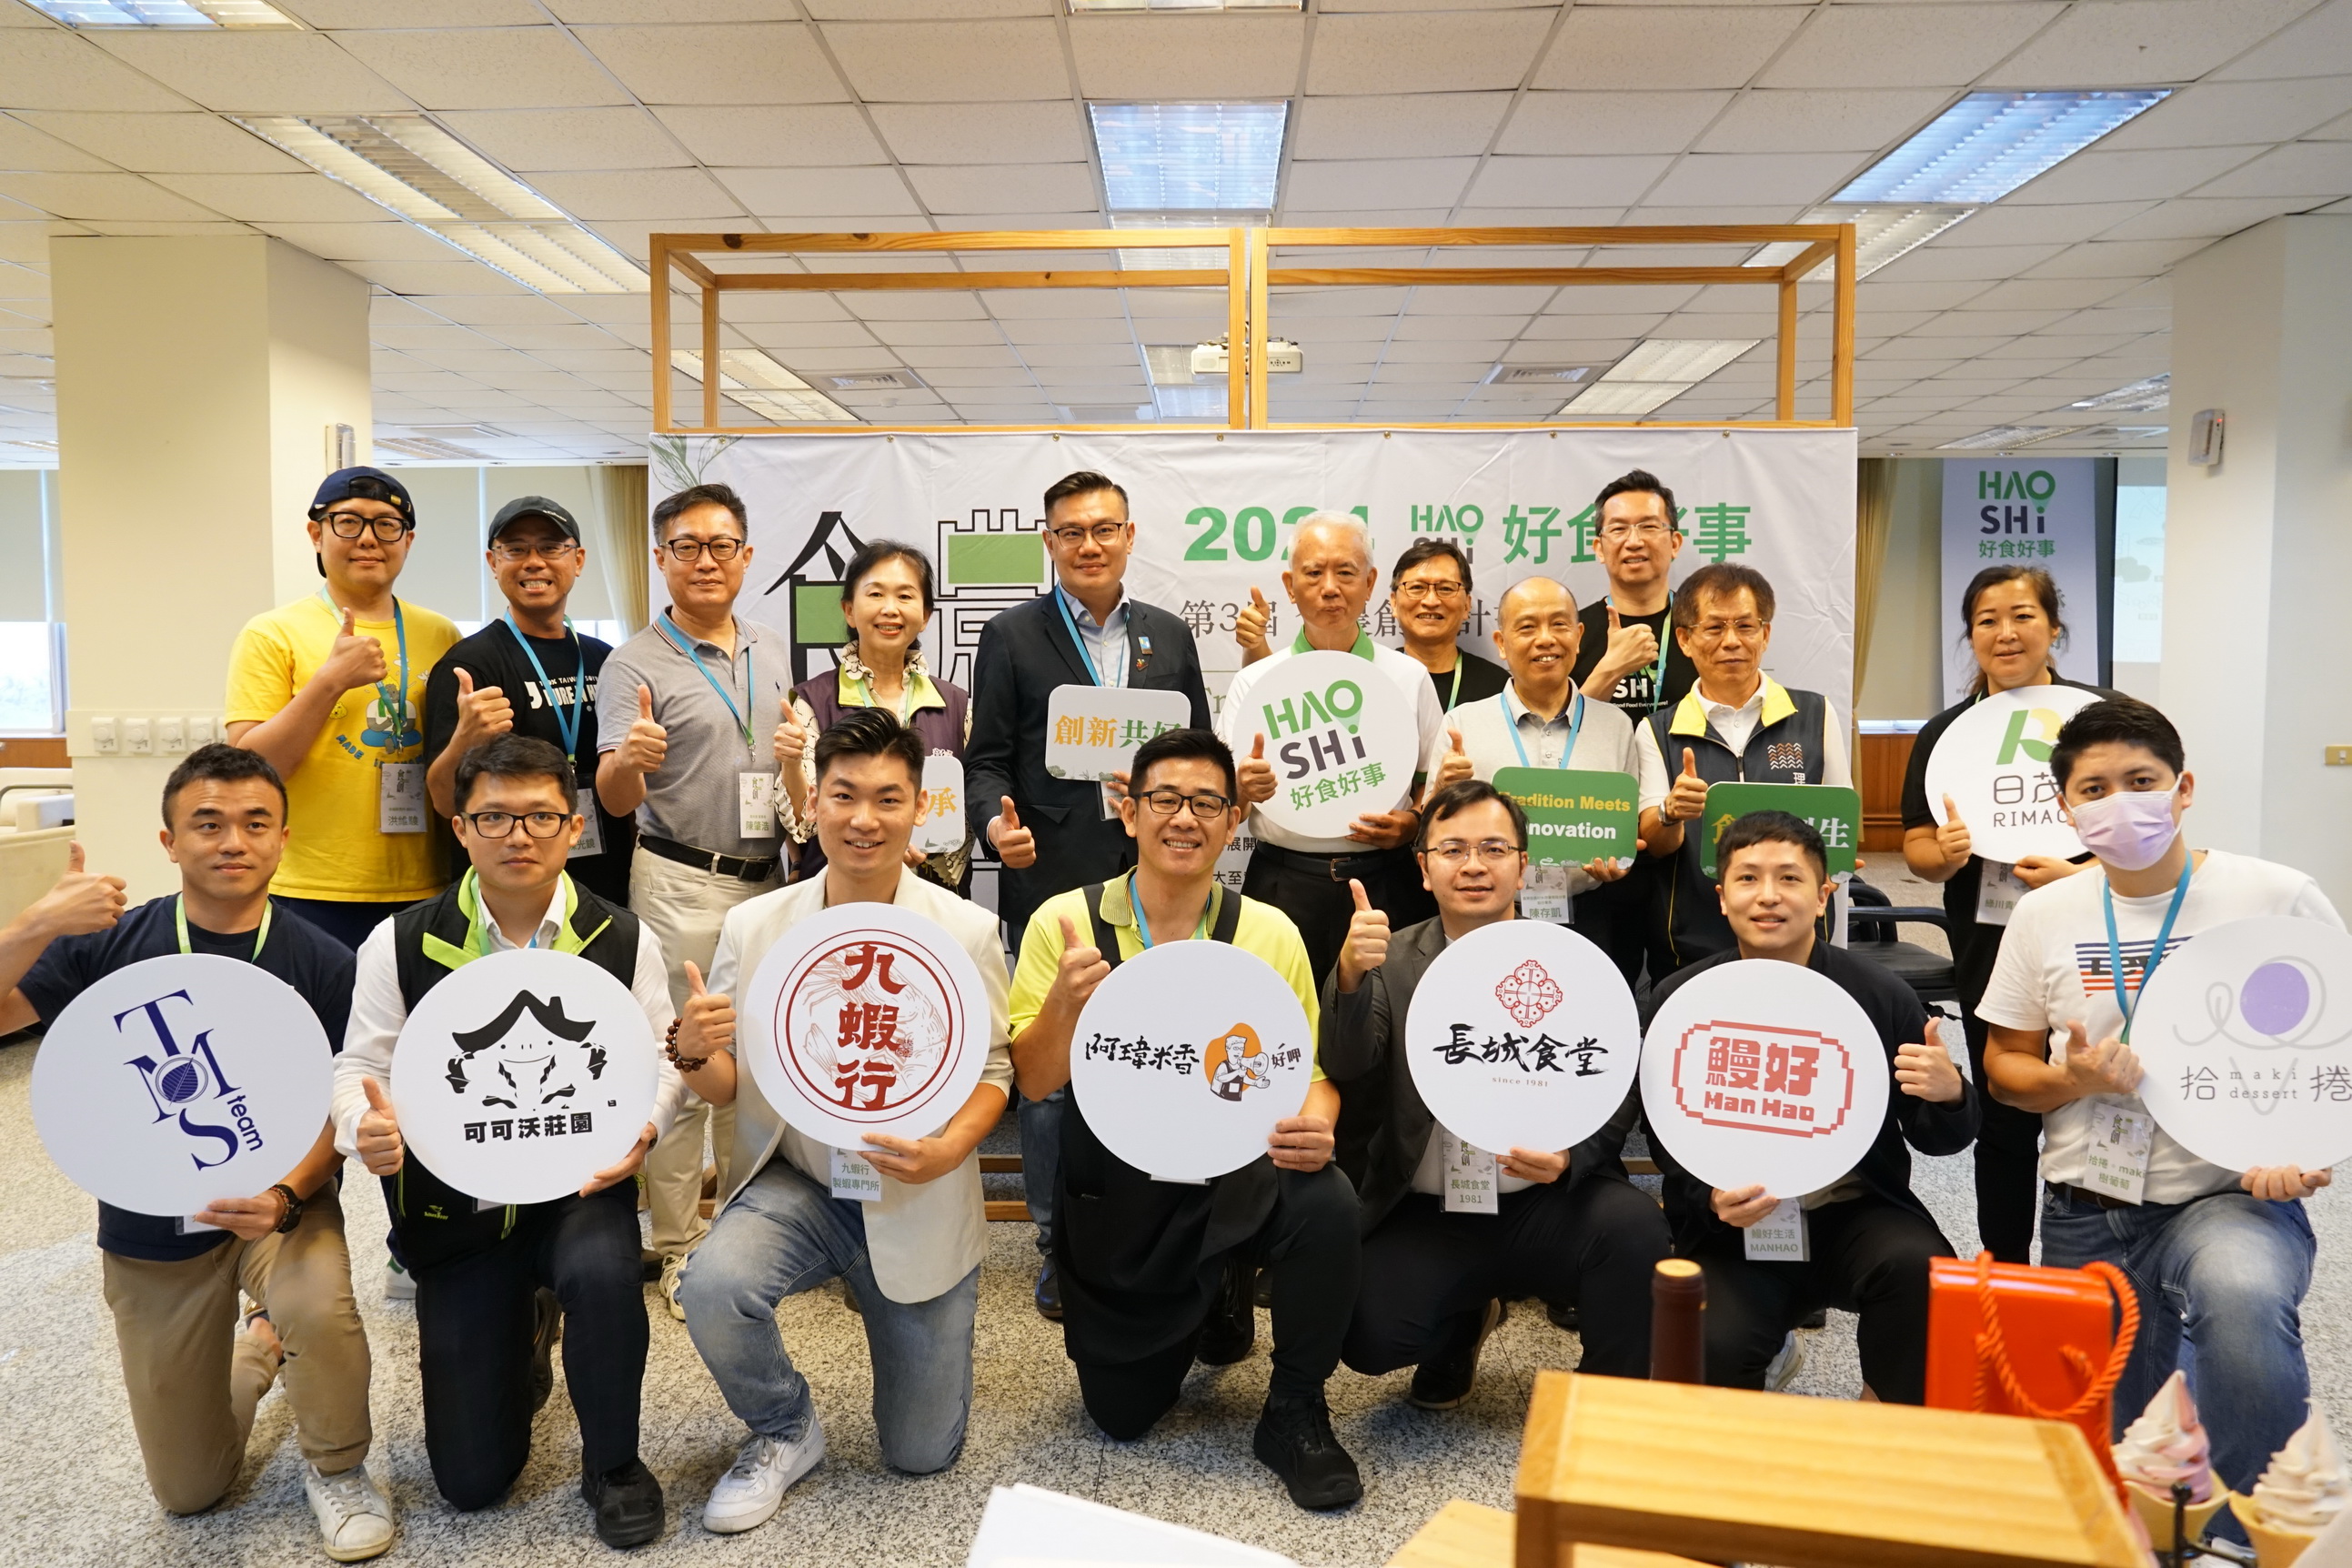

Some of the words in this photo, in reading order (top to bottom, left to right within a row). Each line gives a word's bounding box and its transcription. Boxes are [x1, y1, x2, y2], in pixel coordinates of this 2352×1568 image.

[1978, 470, 2055, 500] HAO
[1412, 504, 1483, 533] HAO
[1978, 539, 2055, 558] 好食好事
[1262, 679, 1363, 739] HAO
[336, 734, 365, 760] MADE
[1290, 761, 1386, 811] 好食好事
[927, 787, 957, 818] 承
[1580, 796, 1630, 811] Meets
[746, 821, 769, 831] 陳肇浩
[1526, 822, 1615, 839] novation
[1212, 870, 1247, 885] 大至
[835, 943, 908, 1110] 九蝦行
[1085, 1033, 1200, 1075] 阿瑋米香
[1432, 1023, 1610, 1077] 長城食堂
[1705, 1036, 1820, 1097] 鰻好
[2229, 1068, 2297, 1080] maki
[1492, 1076, 1521, 1085] since
[1525, 1079, 1549, 1088] 1981
[2229, 1087, 2297, 1099] dessert
[1704, 1091, 1756, 1114] Man
[1762, 1098, 1814, 1121] Hao
[226, 1094, 264, 1151] team
[464, 1111, 592, 1143] 可可沃莊園
[841, 1163, 869, 1175] 九蝦行
[1451, 1180, 1491, 1191] 長城食堂
[1459, 1194, 1483, 1203] 1981
[1751, 1229, 1795, 1239] 鰻好生活
[1750, 1243, 1799, 1252] MANHAO
